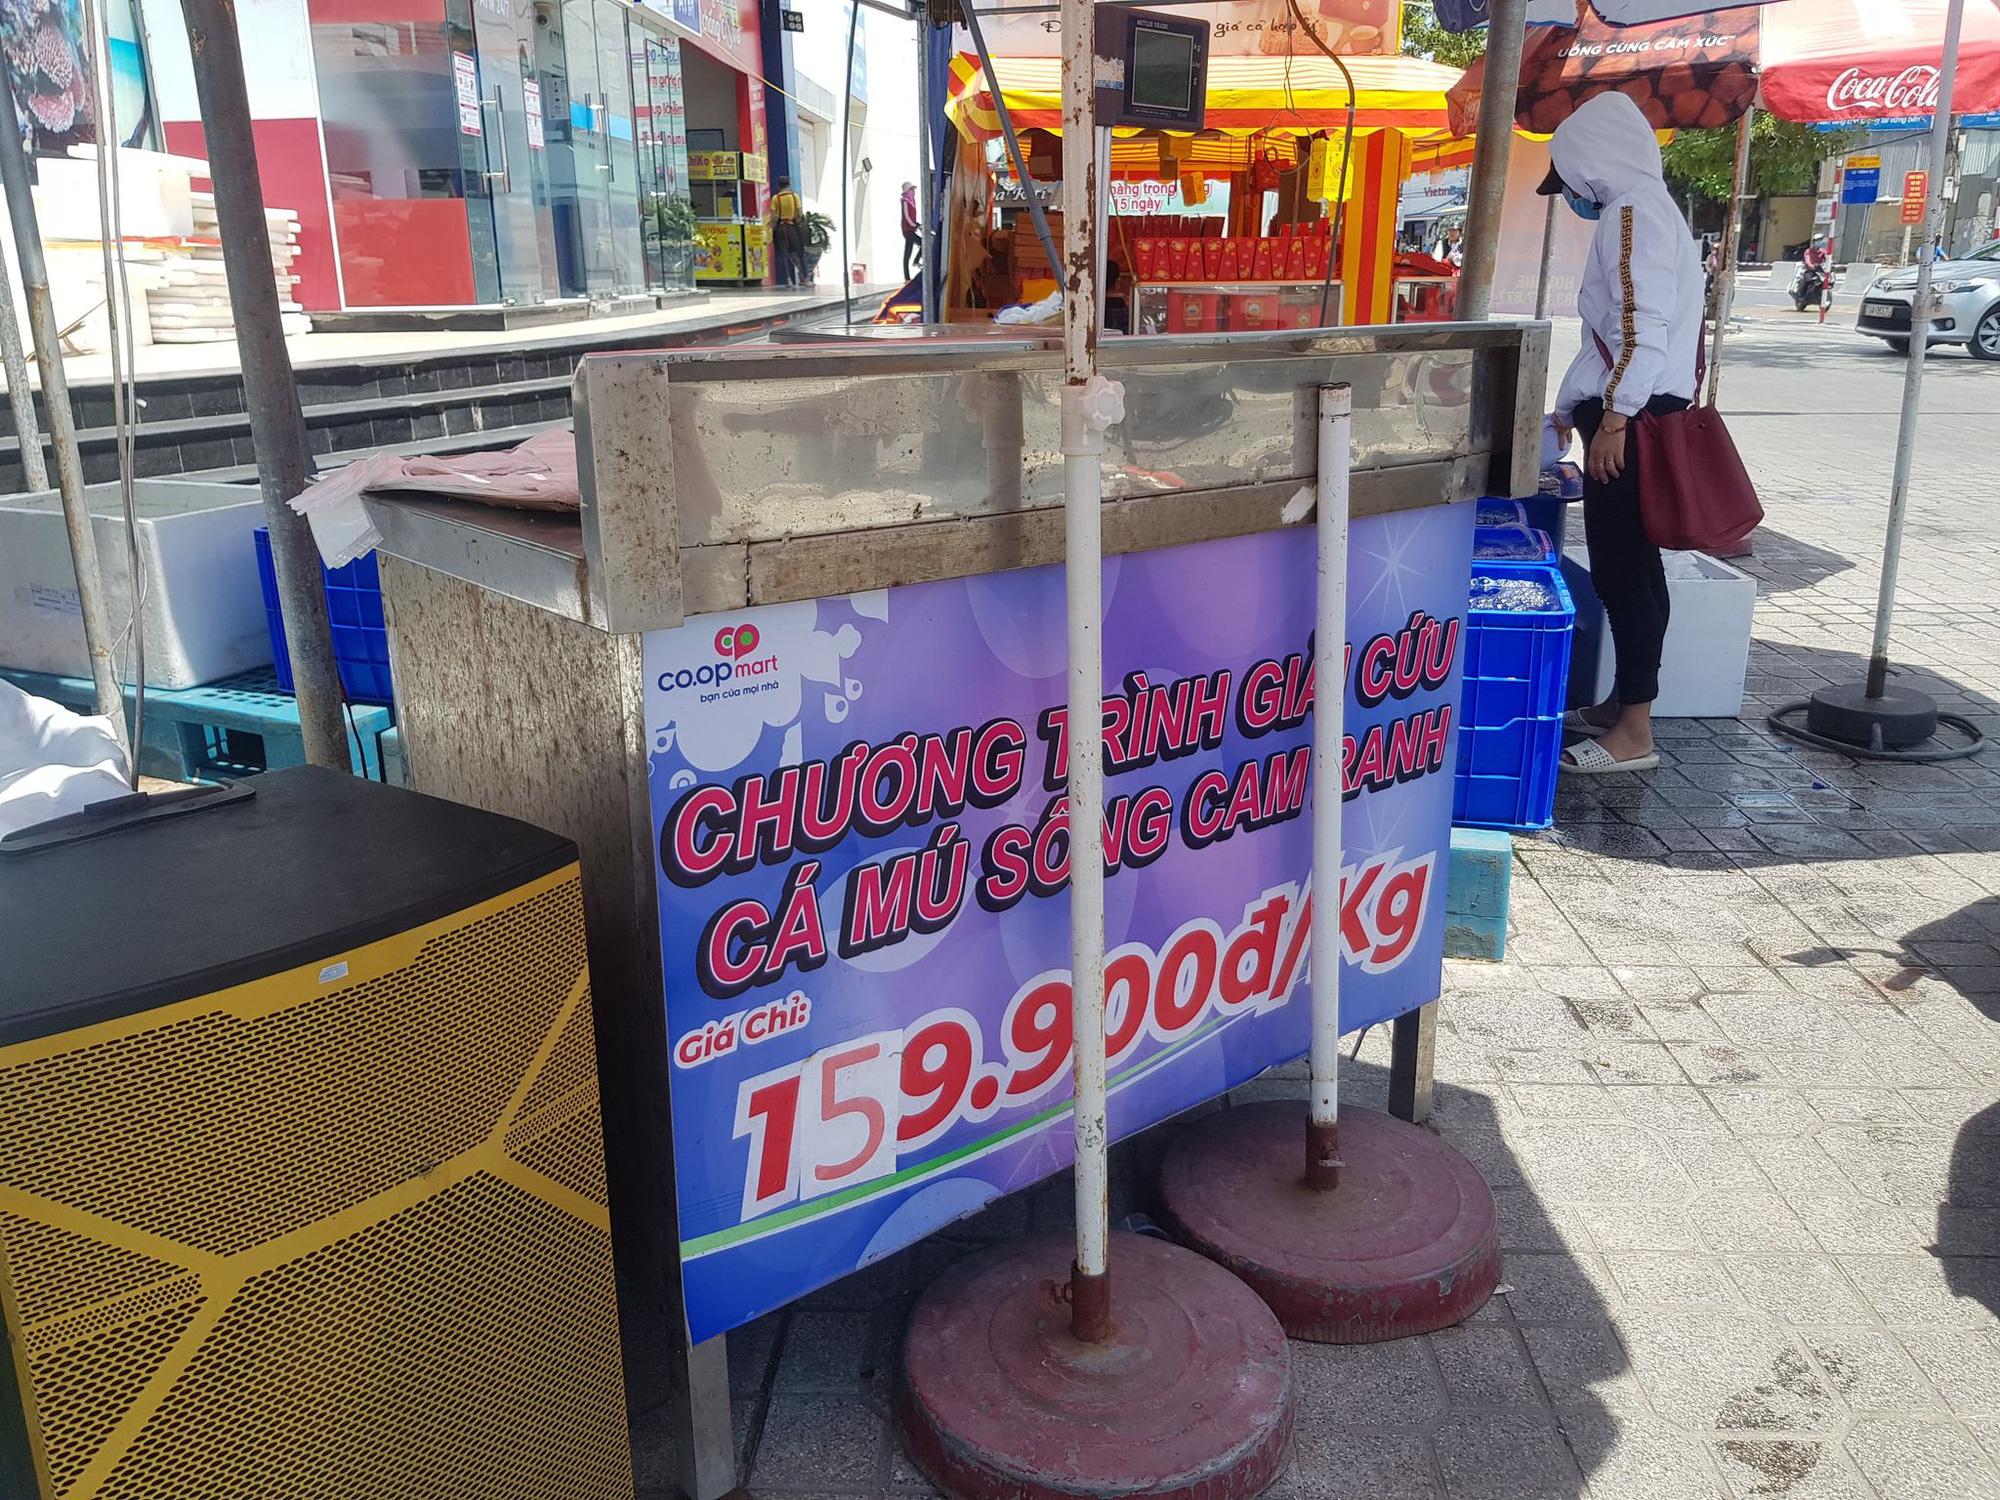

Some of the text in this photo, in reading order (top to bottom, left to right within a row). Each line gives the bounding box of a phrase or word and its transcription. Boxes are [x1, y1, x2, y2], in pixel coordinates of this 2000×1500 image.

[1214, 20, 1242, 38] giá
[1246, 19, 1266, 32] cả
[1012, 186, 1048, 201] Rti
[1143, 184, 1176, 197] trong
[1131, 197, 1162, 212] ngày
[734, 654, 779, 679] mart
[700, 680, 780, 704] bạn của mọi nhà
[670, 718, 1027, 880] CHƯƠNG
[1046, 671, 1232, 782] TRÌNH
[1358, 611, 1459, 699] CỨU
[705, 861, 826, 986] CÁ
[847, 825, 970, 946] MÚ
[1186, 745, 1311, 840] CAM
[679, 993, 808, 1065] Giá Chỉ:
